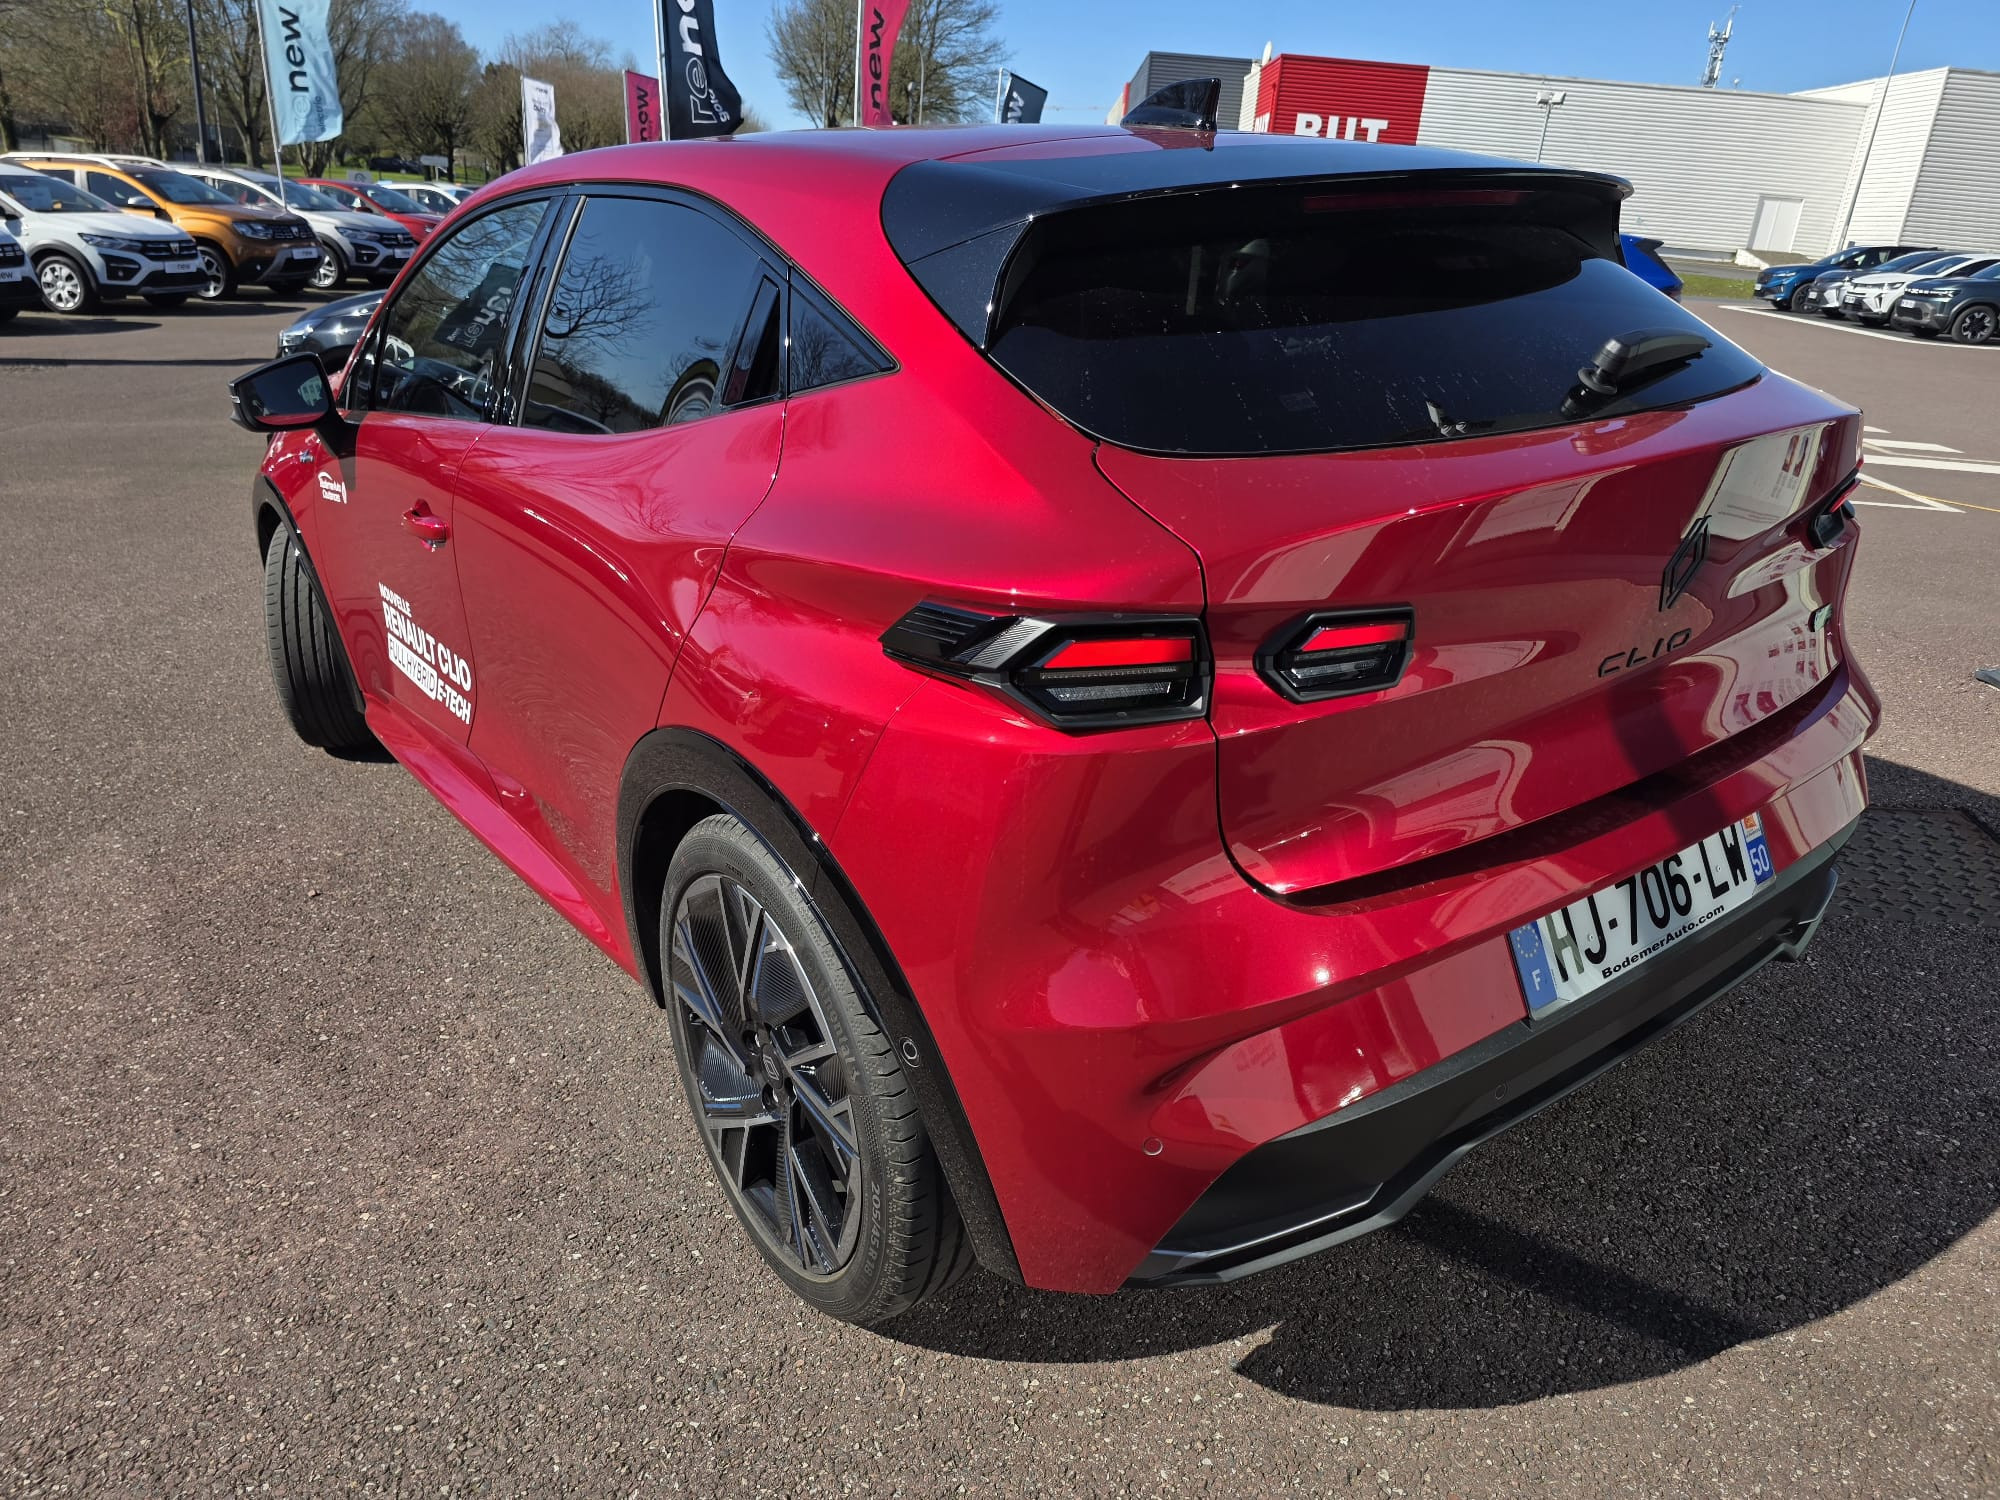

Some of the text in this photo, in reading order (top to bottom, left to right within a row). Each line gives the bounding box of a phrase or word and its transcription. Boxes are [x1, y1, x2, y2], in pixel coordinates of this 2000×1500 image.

[379, 581, 412, 618] NOUVELLE
[382, 600, 472, 692] RENAULT CLIO
[389, 637, 435, 693] FULL HYBRID
[1598, 628, 1692, 677] CLIO
[437, 678, 472, 725] E-TECH
[1749, 844, 1770, 876] 50
[1601, 904, 1726, 979] BodemerAuto.com
[1531, 968, 1542, 991] F
[870, 1180, 881, 1248] 205/45
